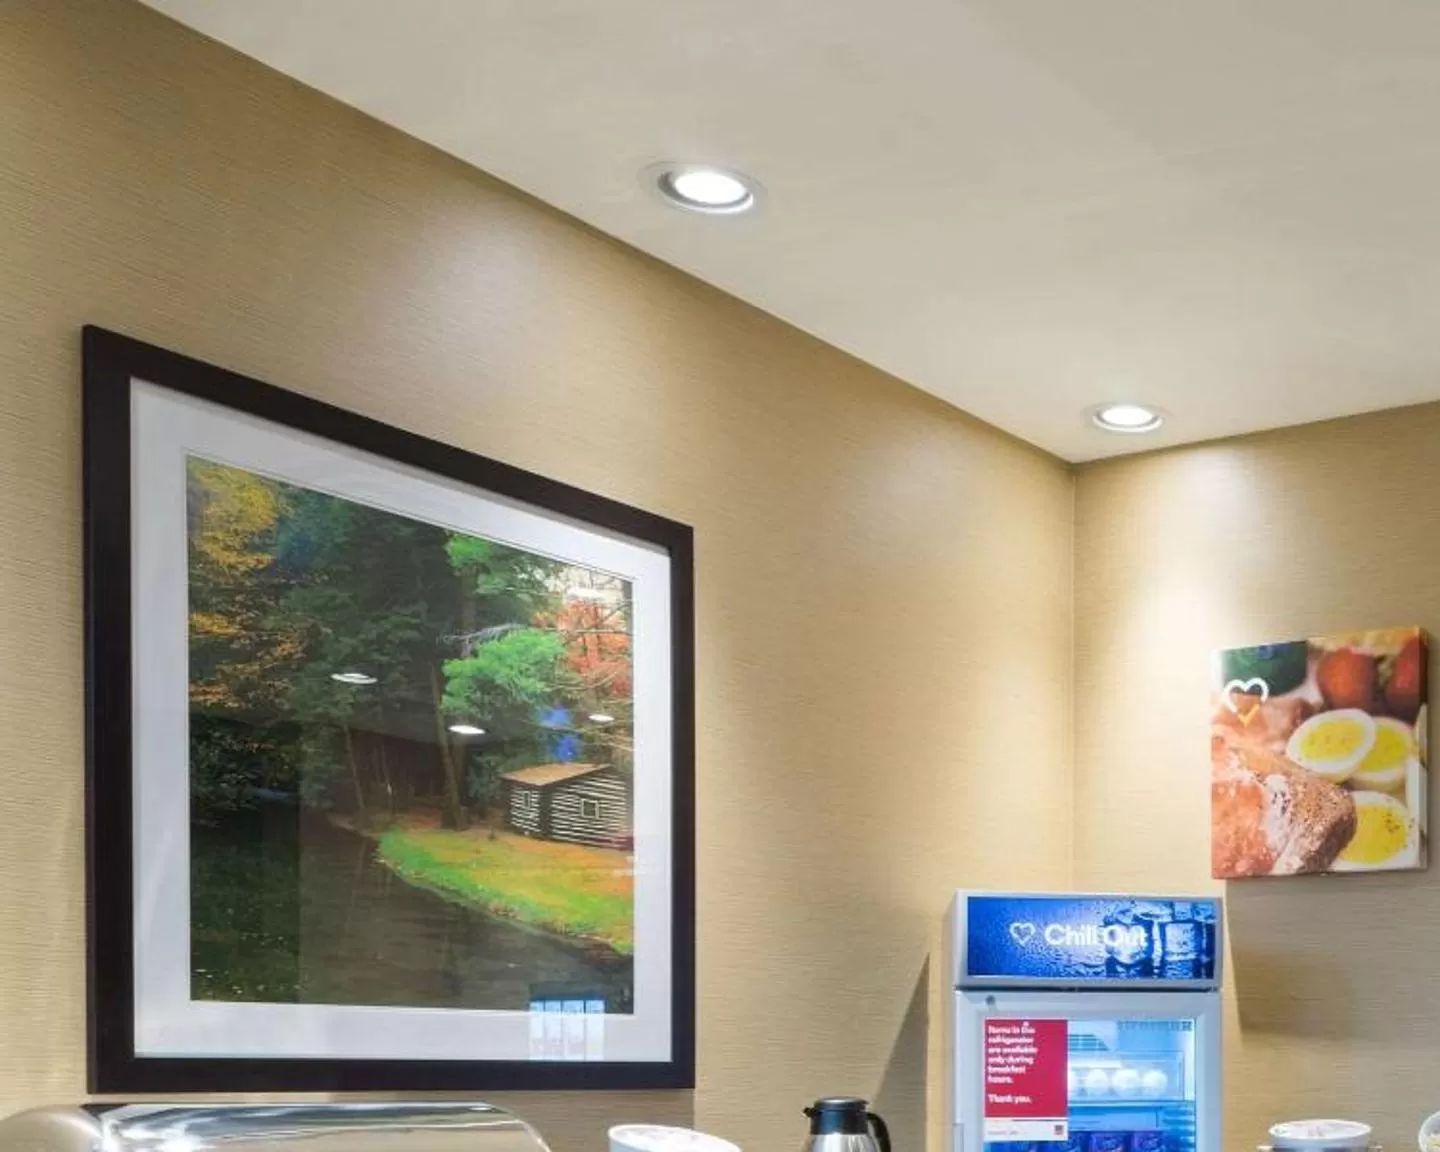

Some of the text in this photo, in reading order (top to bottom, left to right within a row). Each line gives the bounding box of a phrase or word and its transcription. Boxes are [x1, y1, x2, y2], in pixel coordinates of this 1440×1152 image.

[1044, 923, 1147, 947] Chill Out
[987, 1093, 1013, 1103] Thank
